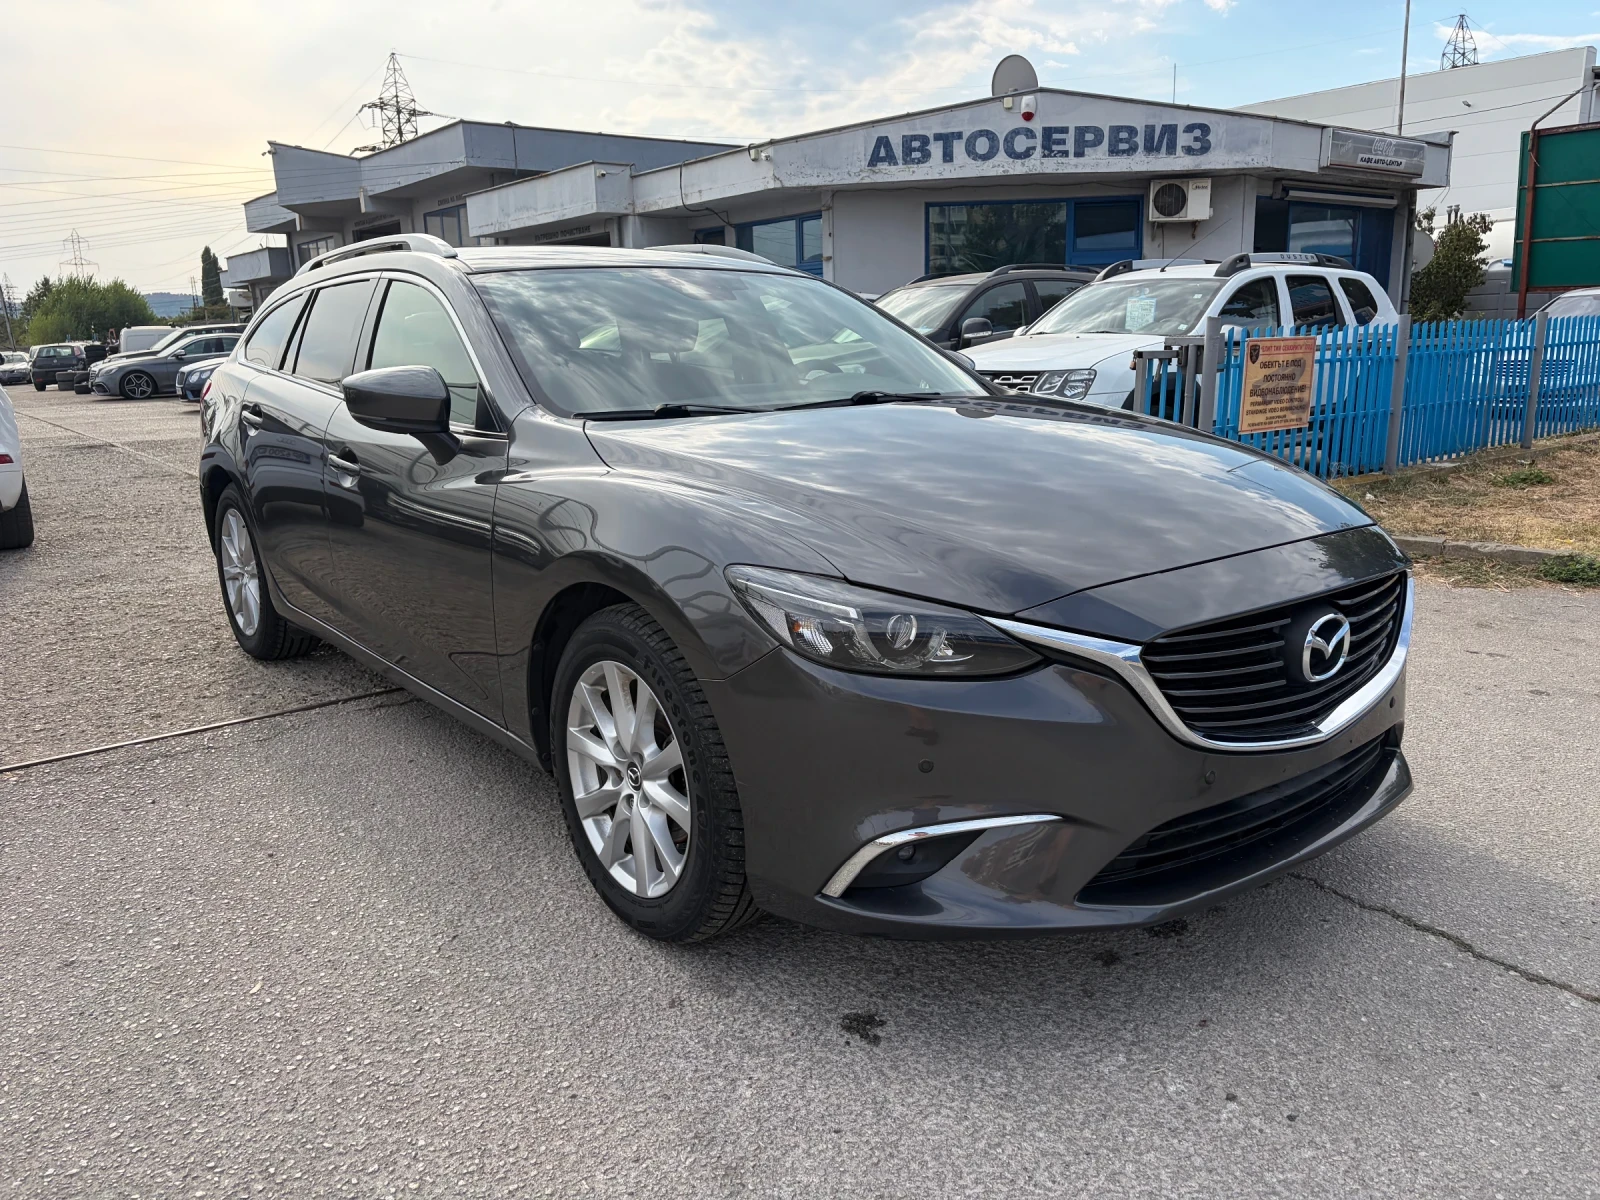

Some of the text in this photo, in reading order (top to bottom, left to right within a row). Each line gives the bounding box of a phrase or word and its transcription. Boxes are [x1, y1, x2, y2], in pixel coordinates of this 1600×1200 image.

[866, 122, 1212, 168] АВТОСЕРВИЗ
[1360, 156, 1373, 164] КАФЕ
[560, 225, 592, 238] ПОЧИСТВАНЕ
[1280, 253, 1316, 261] DUSTER
[1259, 359, 1302, 369] ОБЕКТЪТ Е ПОД
[1263, 372, 1297, 383] ПОСТОЯННО
